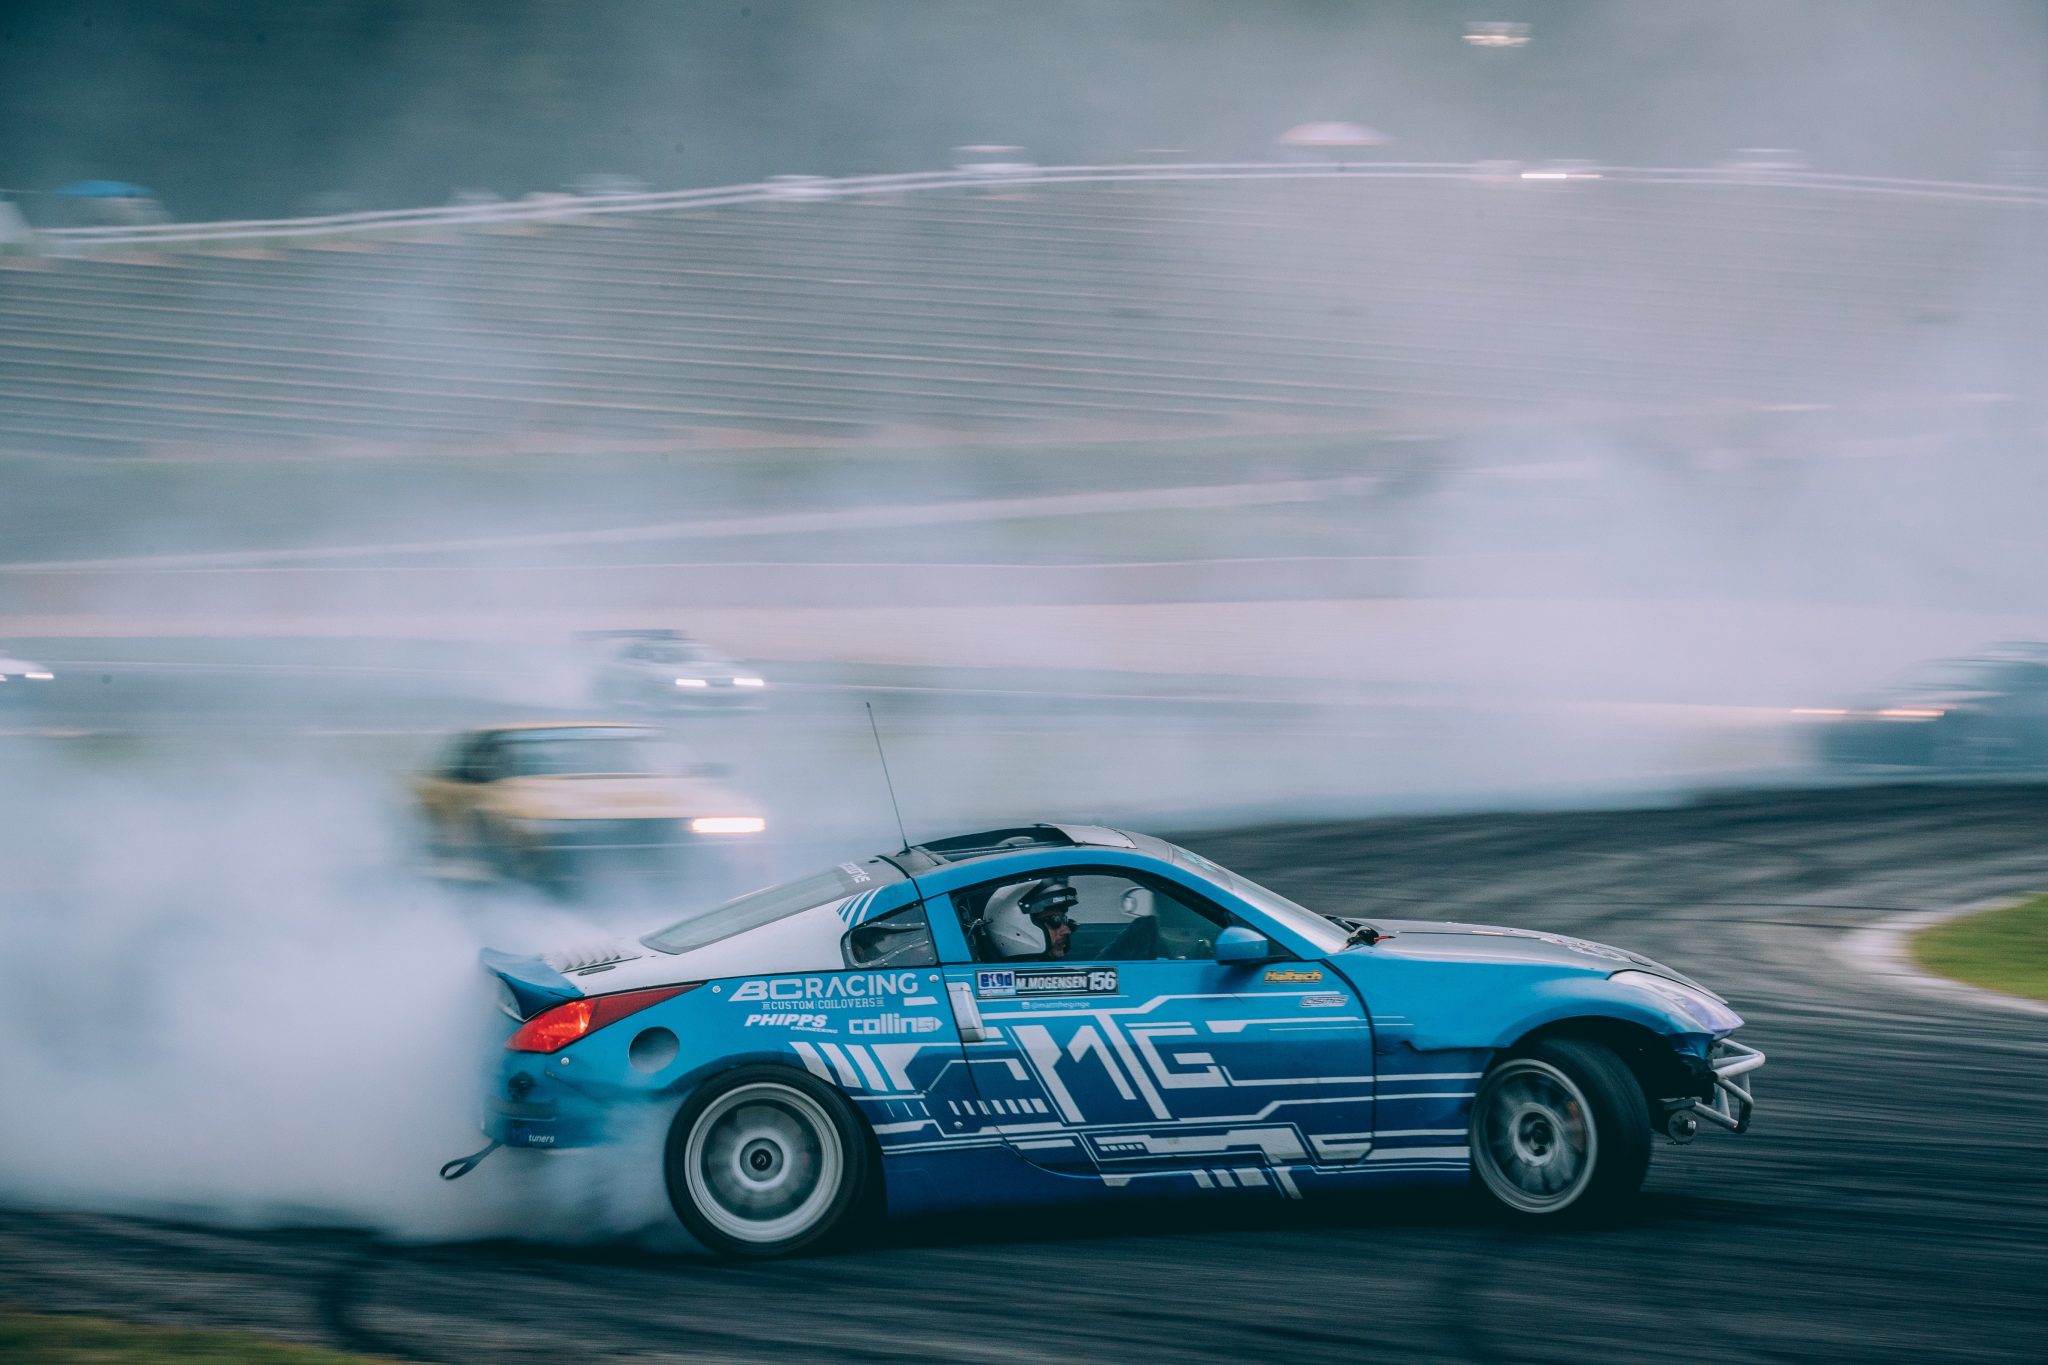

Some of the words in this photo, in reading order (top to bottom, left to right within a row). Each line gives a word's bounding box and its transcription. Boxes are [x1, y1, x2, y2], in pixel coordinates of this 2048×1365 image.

[1087, 971, 1117, 991] 156
[770, 1000, 814, 1011] CUSTOM
[818, 997, 876, 1009] COILOVERS
[744, 1013, 828, 1028] PHIPPS
[528, 1133, 555, 1143] tuners
